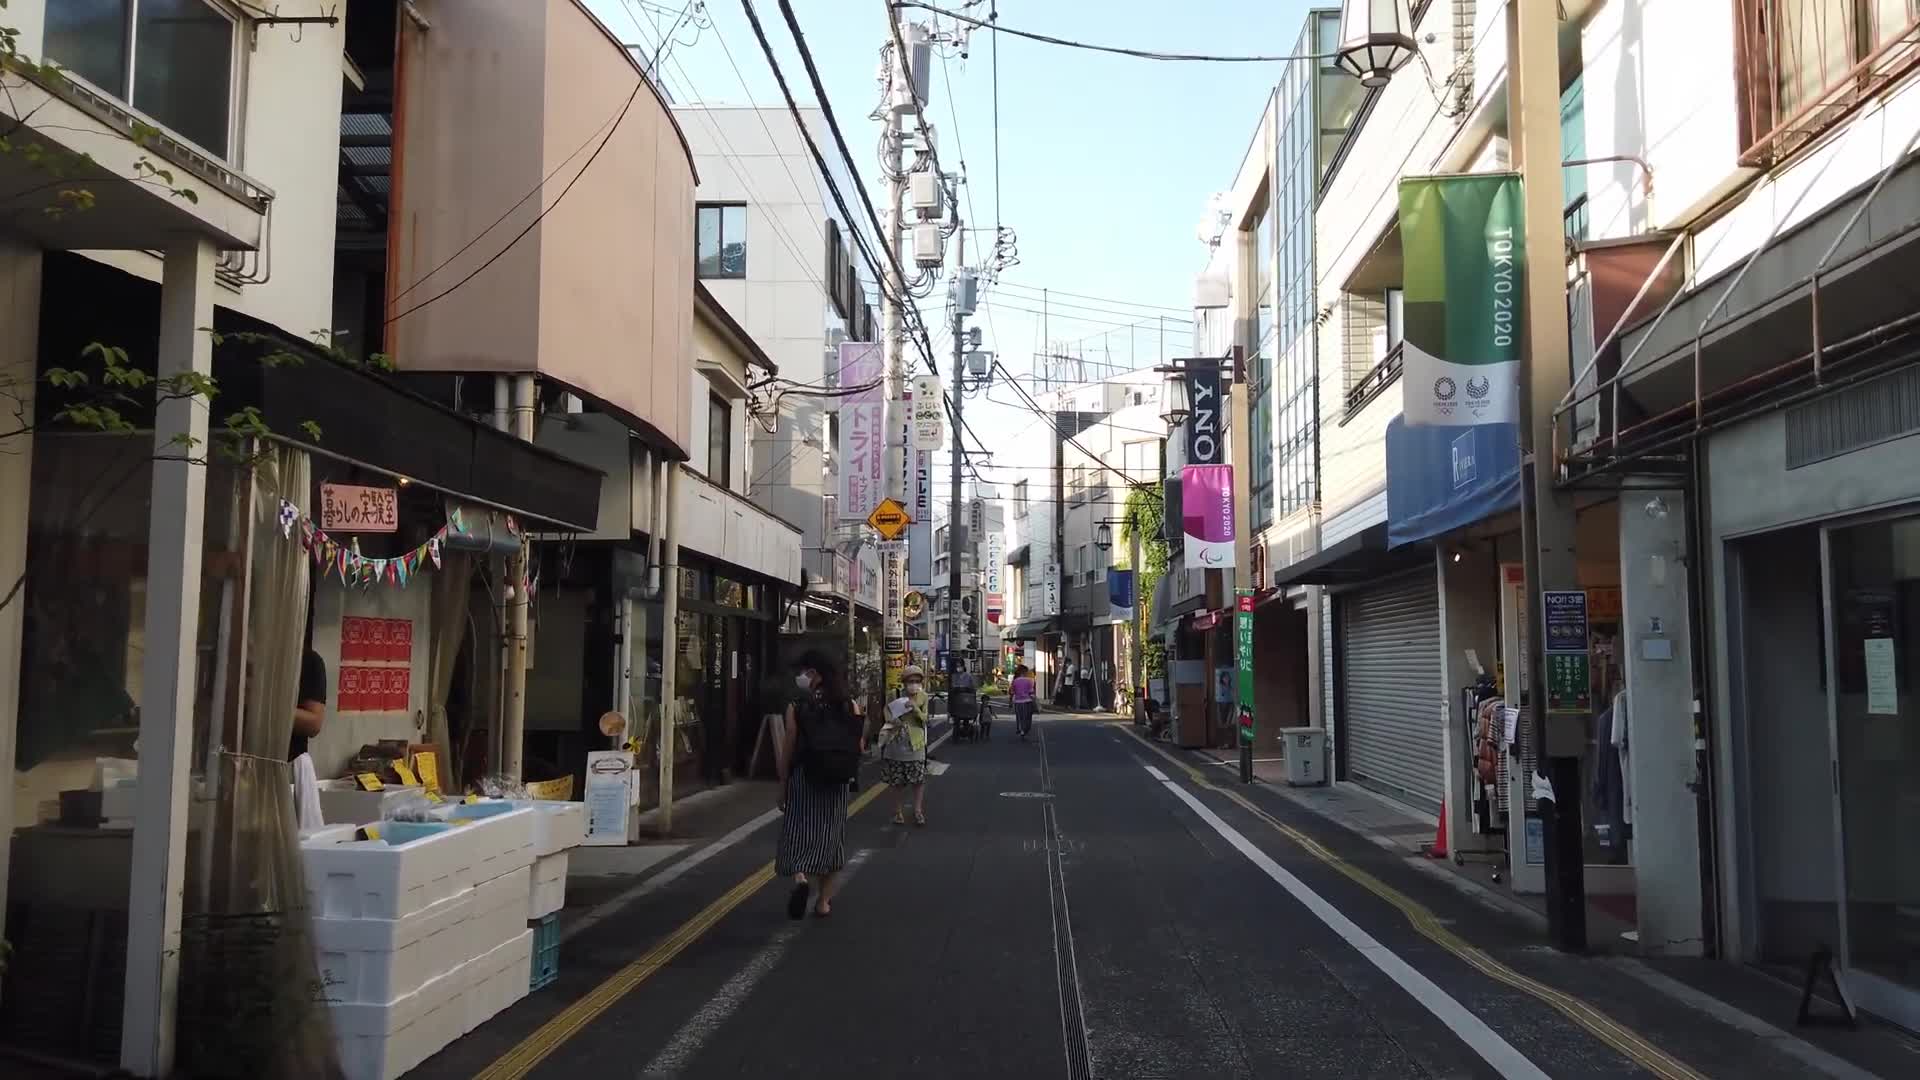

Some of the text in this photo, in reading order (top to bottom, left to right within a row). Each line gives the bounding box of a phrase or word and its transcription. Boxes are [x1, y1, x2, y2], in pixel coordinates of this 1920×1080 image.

[1494, 226, 1513, 347] TOKYO 2020
[1194, 379, 1215, 462] ONY
[323, 486, 396, 528] 暮らしの実験室
[1222, 486, 1232, 537] TOKYO 2020
